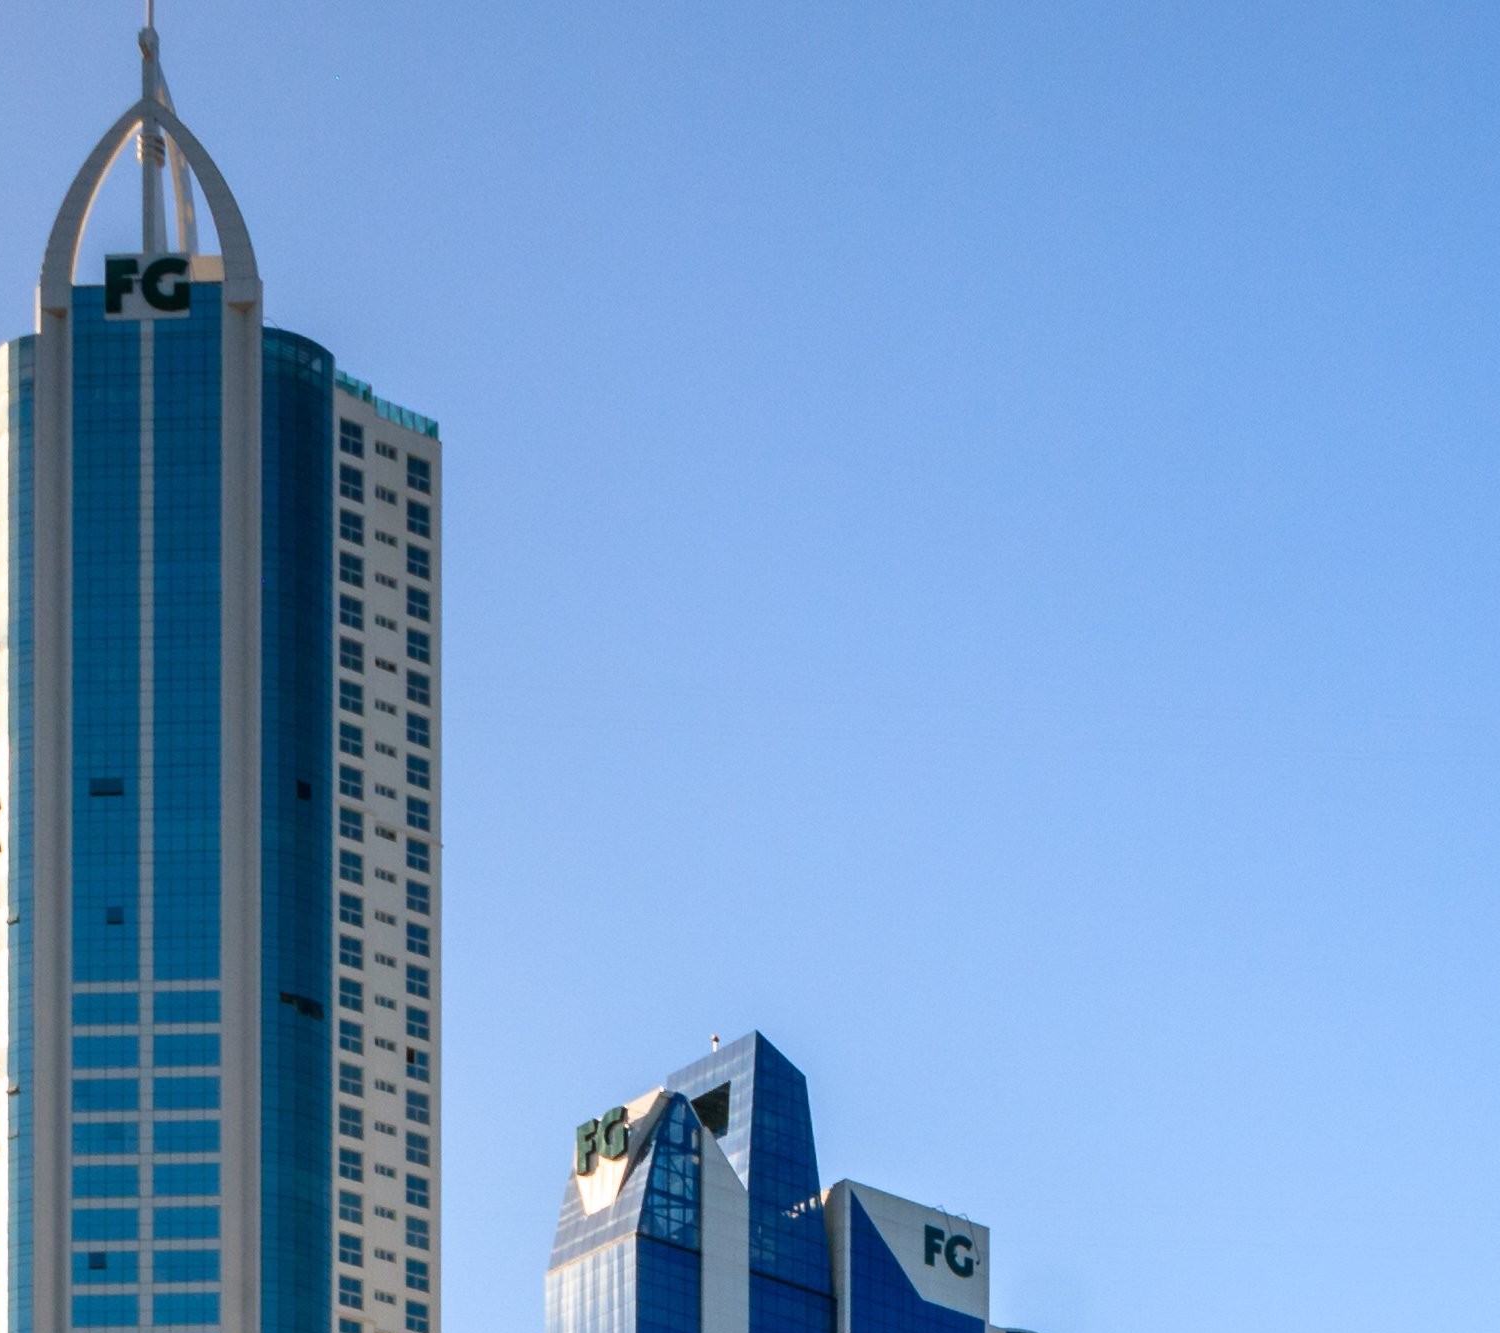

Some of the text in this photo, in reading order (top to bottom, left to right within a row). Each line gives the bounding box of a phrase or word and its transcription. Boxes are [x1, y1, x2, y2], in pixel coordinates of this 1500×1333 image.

[105, 257, 190, 313] FG
[576, 1106, 630, 1176] FG
[924, 1224, 974, 1278] FG
